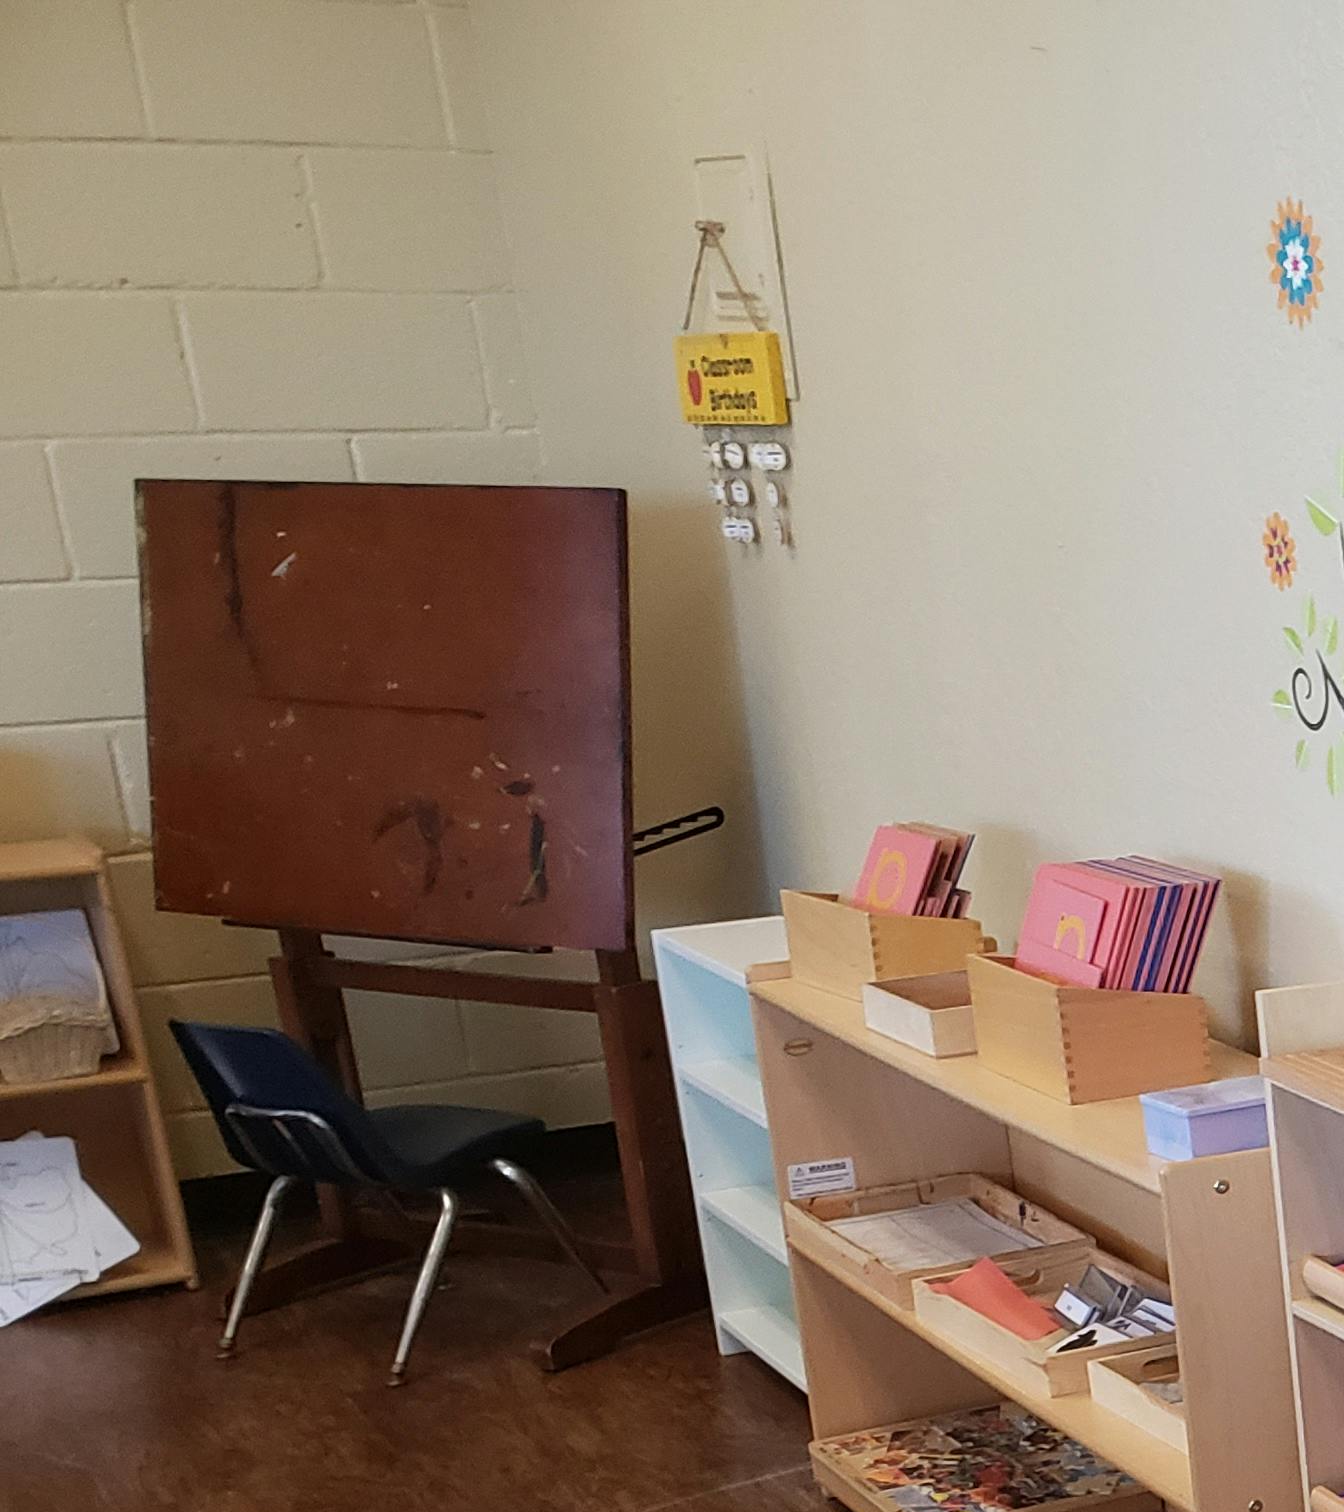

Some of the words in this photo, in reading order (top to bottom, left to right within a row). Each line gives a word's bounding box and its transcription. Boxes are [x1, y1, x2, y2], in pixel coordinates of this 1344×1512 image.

[701, 356, 753, 377] Classroom
[709, 389, 757, 413] Birthdays
[809, 1162, 846, 1173] WARNING
